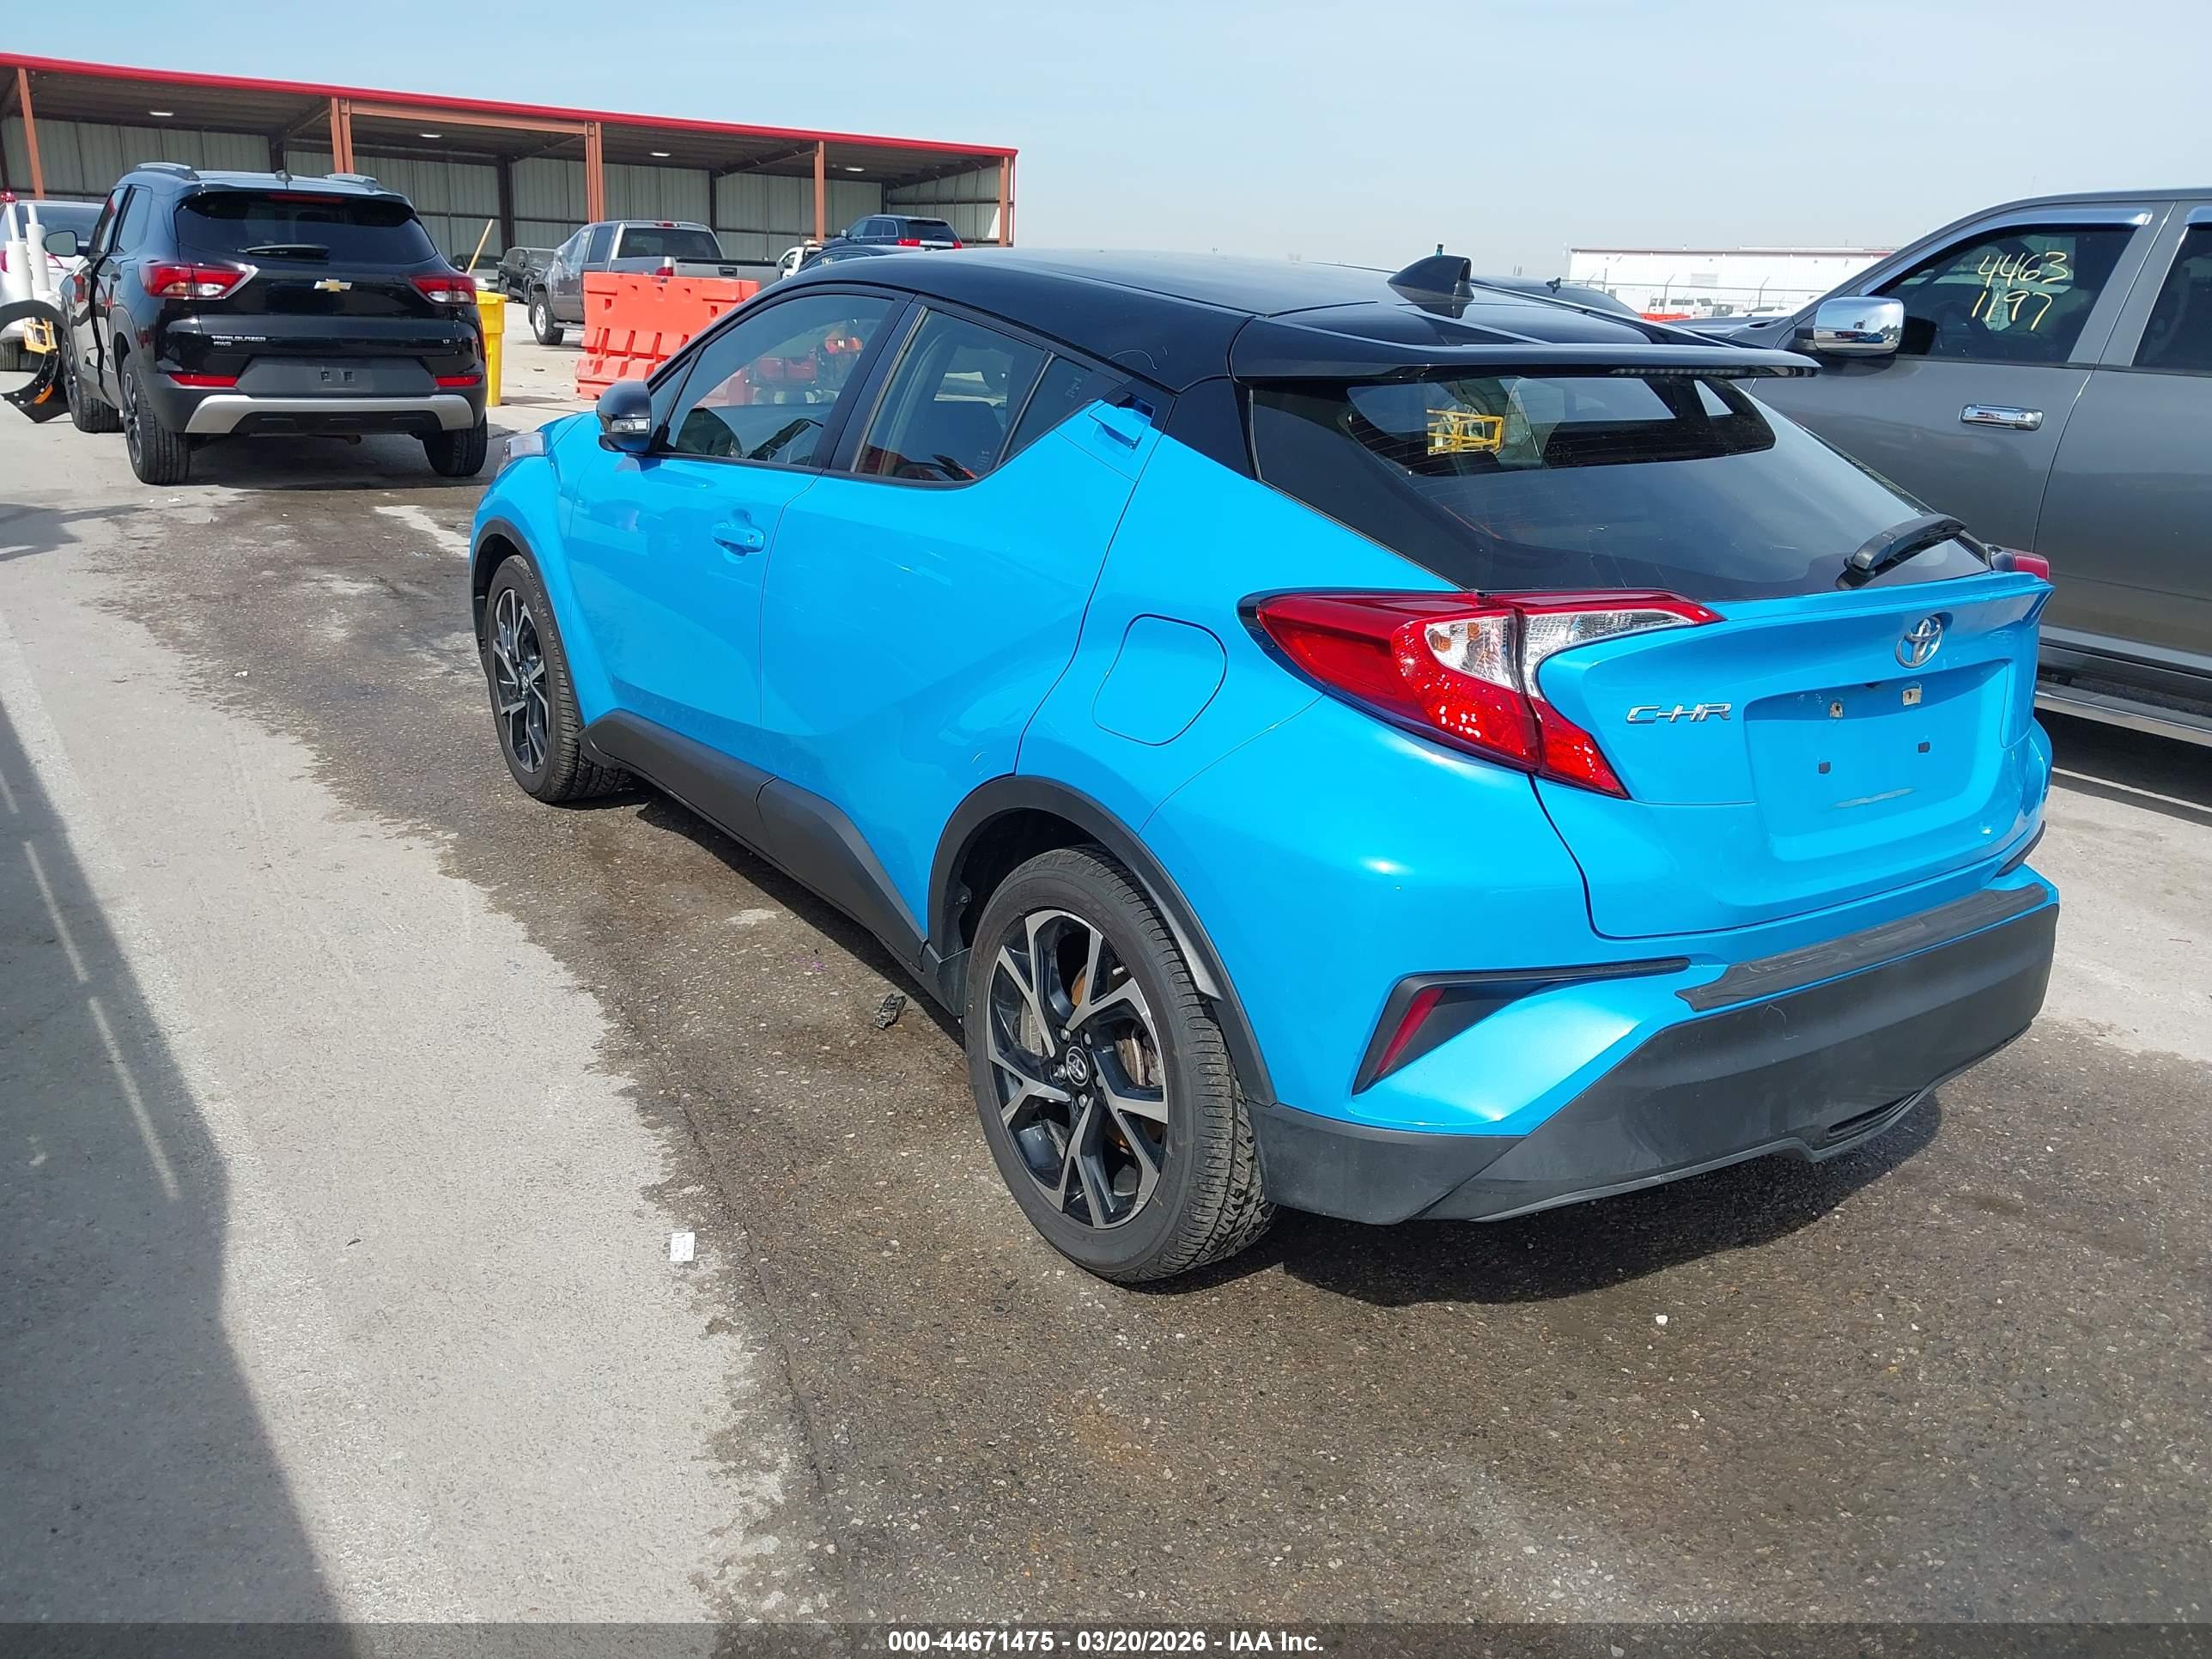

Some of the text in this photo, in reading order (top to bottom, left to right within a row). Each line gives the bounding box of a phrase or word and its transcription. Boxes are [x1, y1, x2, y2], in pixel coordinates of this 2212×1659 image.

[1977, 251, 2069, 288] 4463
[1971, 290, 2053, 331] 1197
[1626, 702, 1733, 725] C-HR
